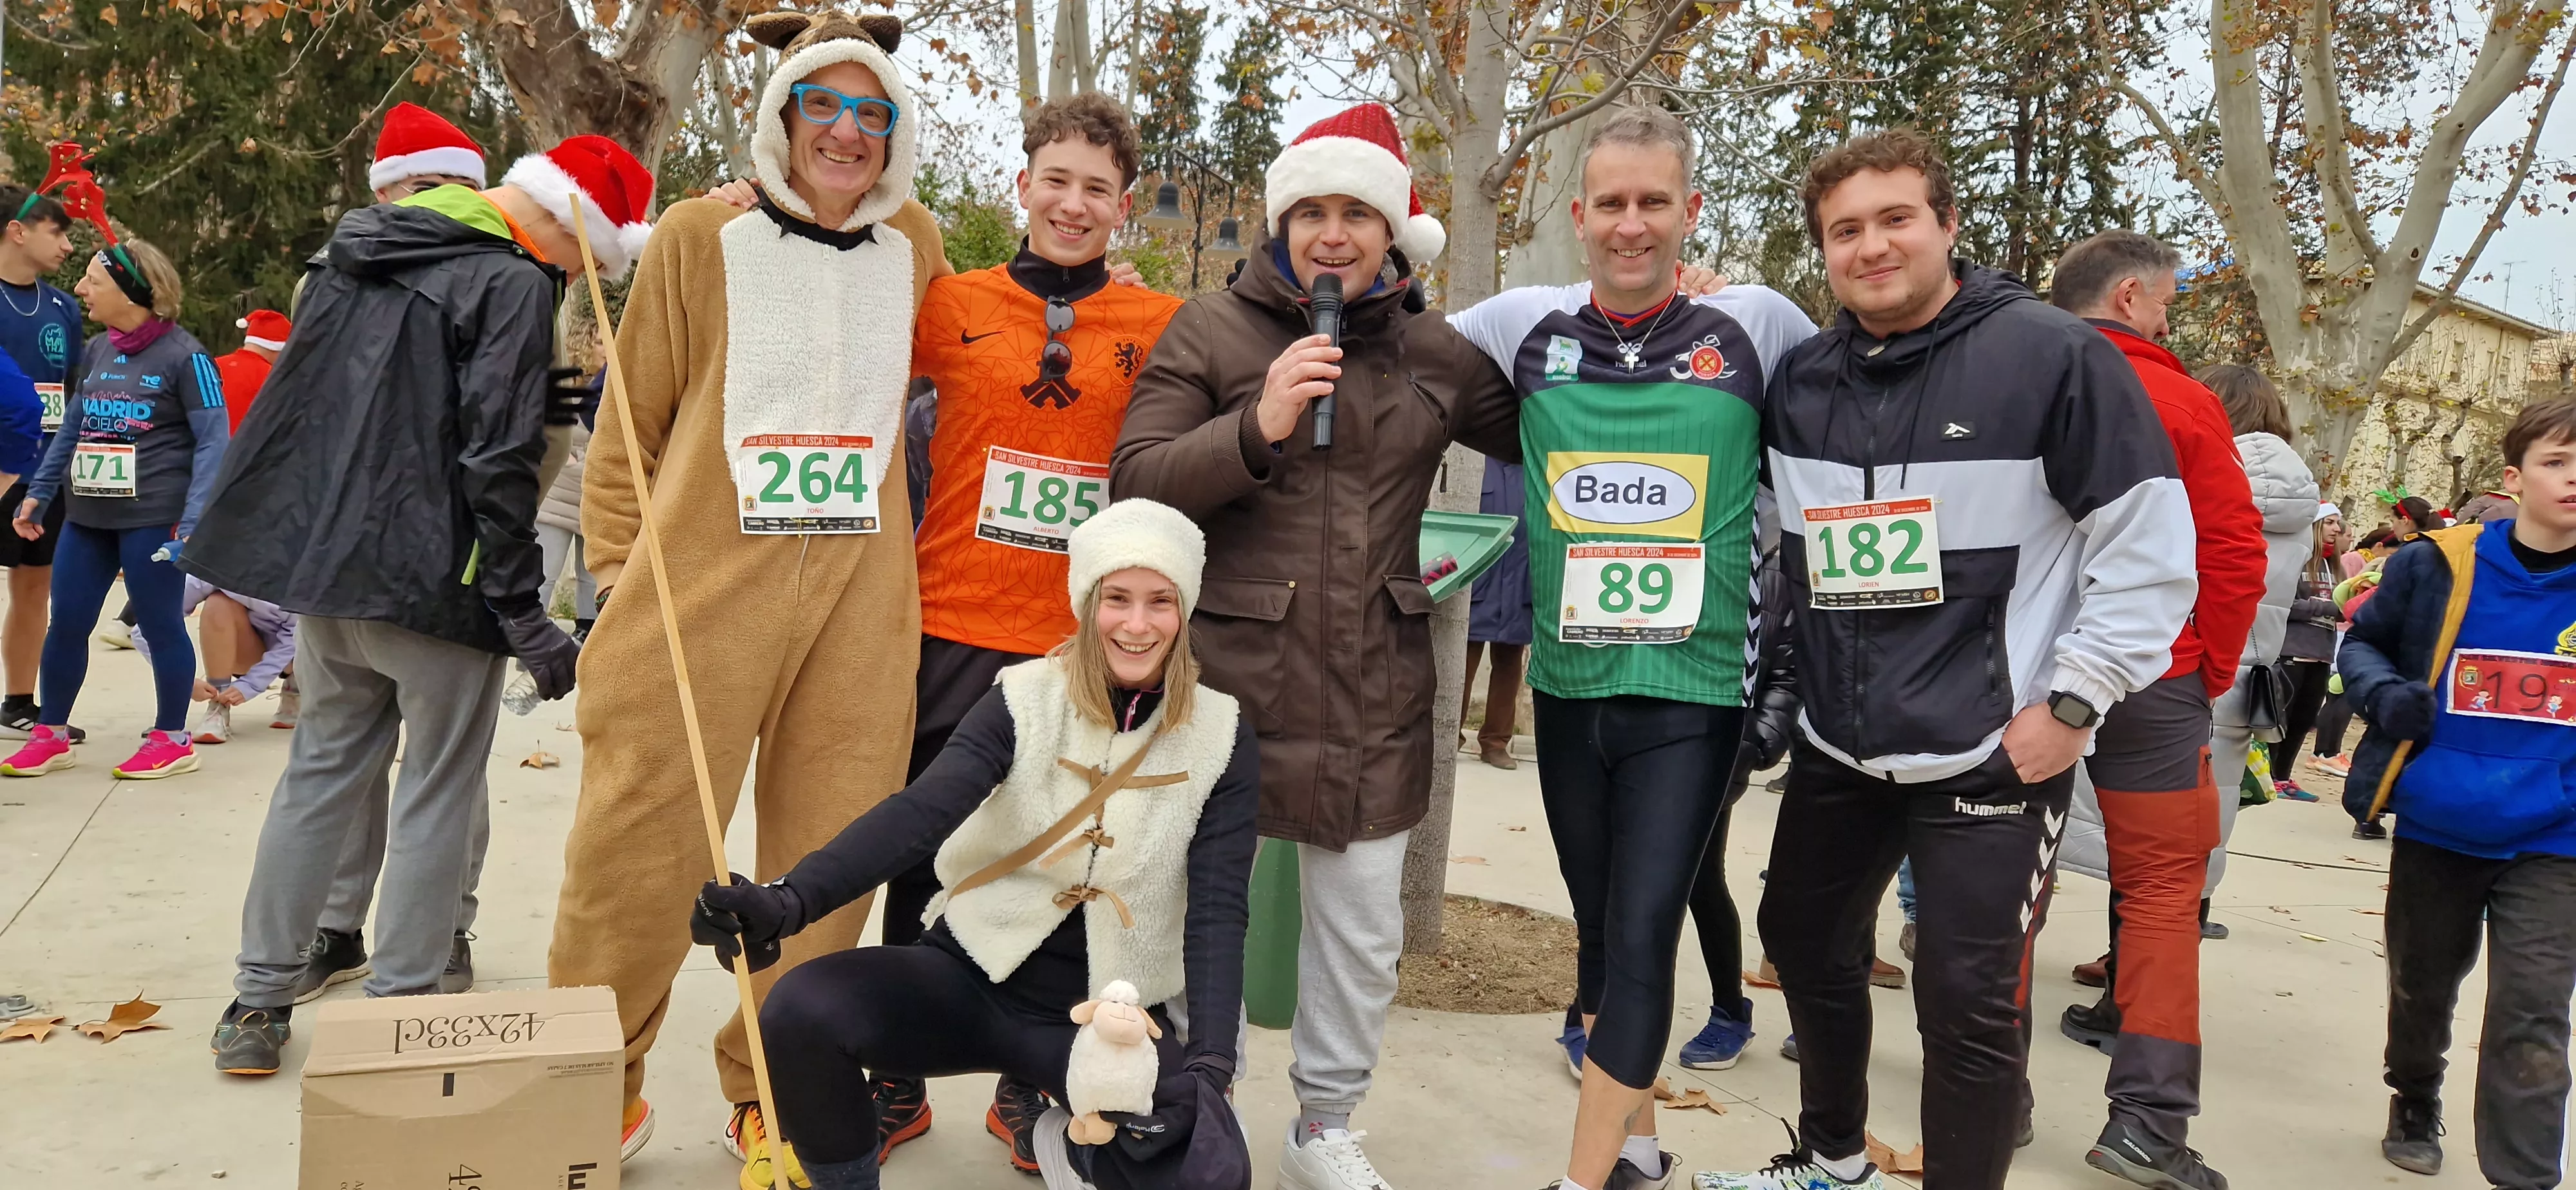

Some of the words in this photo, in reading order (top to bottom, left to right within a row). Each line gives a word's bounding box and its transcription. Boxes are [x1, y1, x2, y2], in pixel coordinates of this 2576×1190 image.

[744, 437, 757, 446] SAN
[759, 436, 794, 446] SILVESTRE
[795, 437, 823, 446] HUESCA
[824, 437, 839, 446] 2024
[76, 453, 128, 480] 171
[995, 451, 1007, 460] SAN
[1008, 453, 1039, 468] SILVESTRE
[1039, 460, 1065, 473] HUESCA
[1066, 465, 1082, 475] 2024
[758, 451, 868, 504] 264
[1575, 475, 1667, 506] Bada
[1000, 471, 1101, 528] 185
[1842, 506, 1870, 517] HUESCA
[1871, 504, 1890, 515] 2024
[1033, 525, 1059, 535] ALBERTO
[1573, 548, 1584, 557] SAN
[1585, 547, 1617, 557] SILVESTRE
[1618, 547, 1645, 556] HUESCA
[1646, 547, 1663, 557] 2024
[1819, 519, 1928, 578] 182
[1598, 562, 1674, 614] 89
[1955, 797, 2027, 816] hummel
[392, 1012, 545, 1055] 42x33cl
[2122, 1138, 2152, 1163] SALOMON
